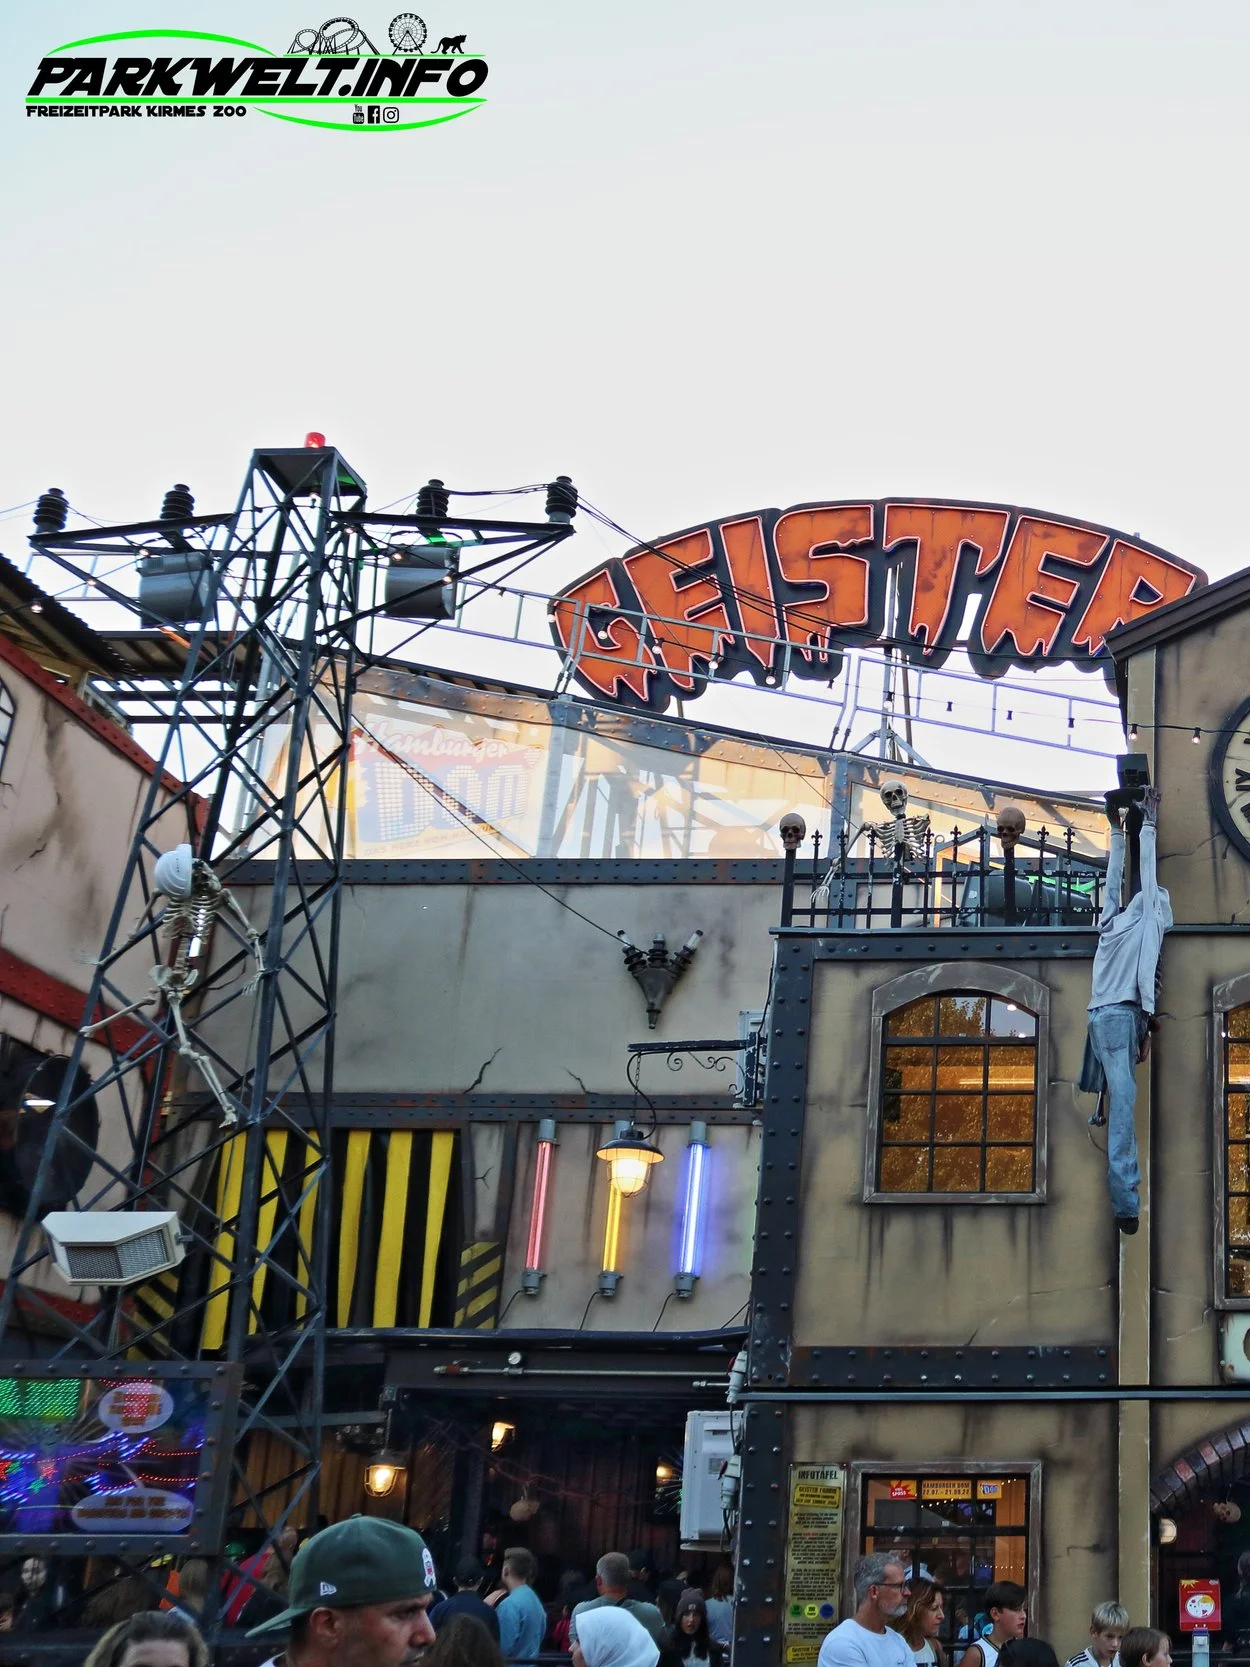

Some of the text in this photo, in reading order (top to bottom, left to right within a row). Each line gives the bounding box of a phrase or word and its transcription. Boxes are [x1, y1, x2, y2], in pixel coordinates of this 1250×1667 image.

[552, 500, 1202, 702] GEISTER
[353, 720, 511, 764] Hamburger
[798, 1470, 838, 1480] INFOTAFEL
